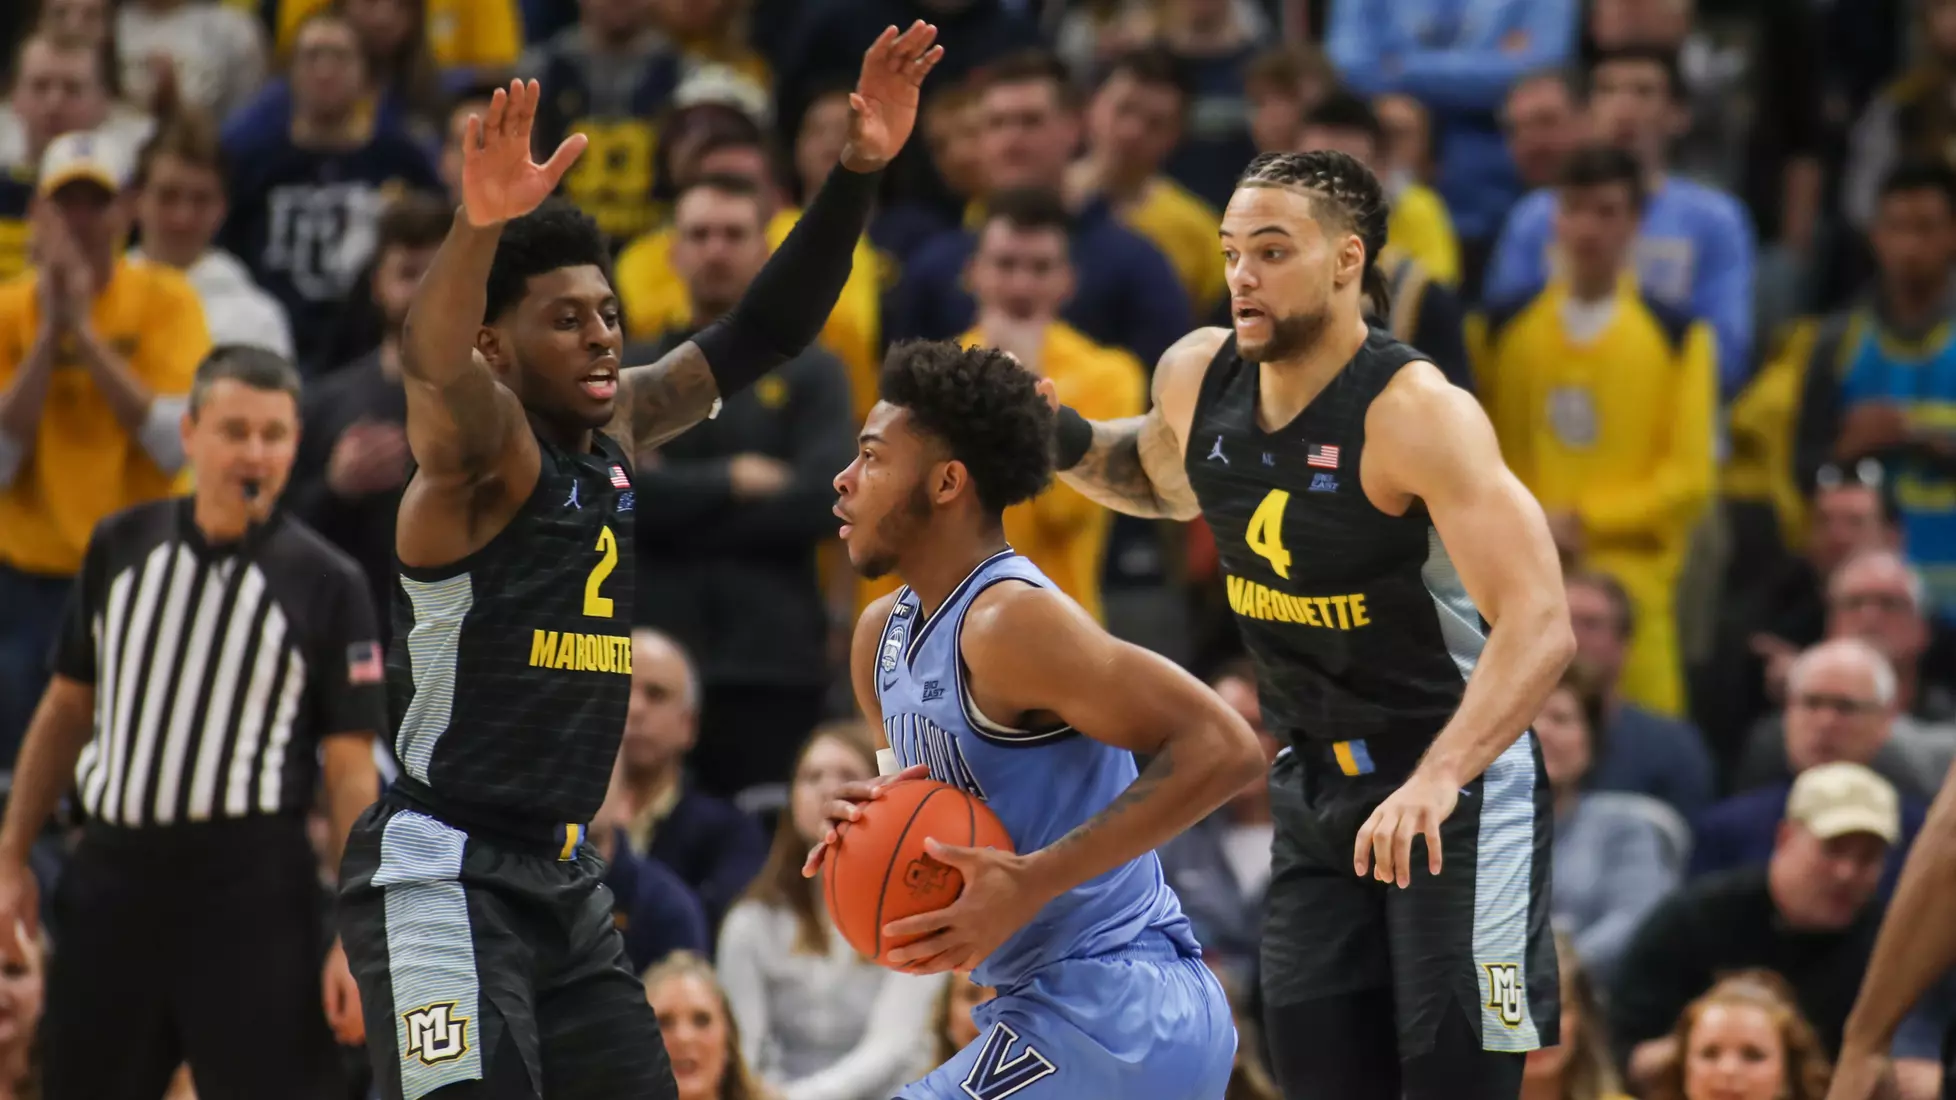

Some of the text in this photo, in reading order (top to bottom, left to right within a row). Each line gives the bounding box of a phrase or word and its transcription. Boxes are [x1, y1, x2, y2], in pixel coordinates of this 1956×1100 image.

[1245, 488, 1291, 580] 4
[582, 525, 618, 617] 2
[1226, 574, 1371, 630] MARQUETTE
[922, 688, 945, 698] EAST
[1482, 962, 1523, 1028] MU
[402, 1000, 470, 1067] MU
[959, 1020, 1058, 1100] V
